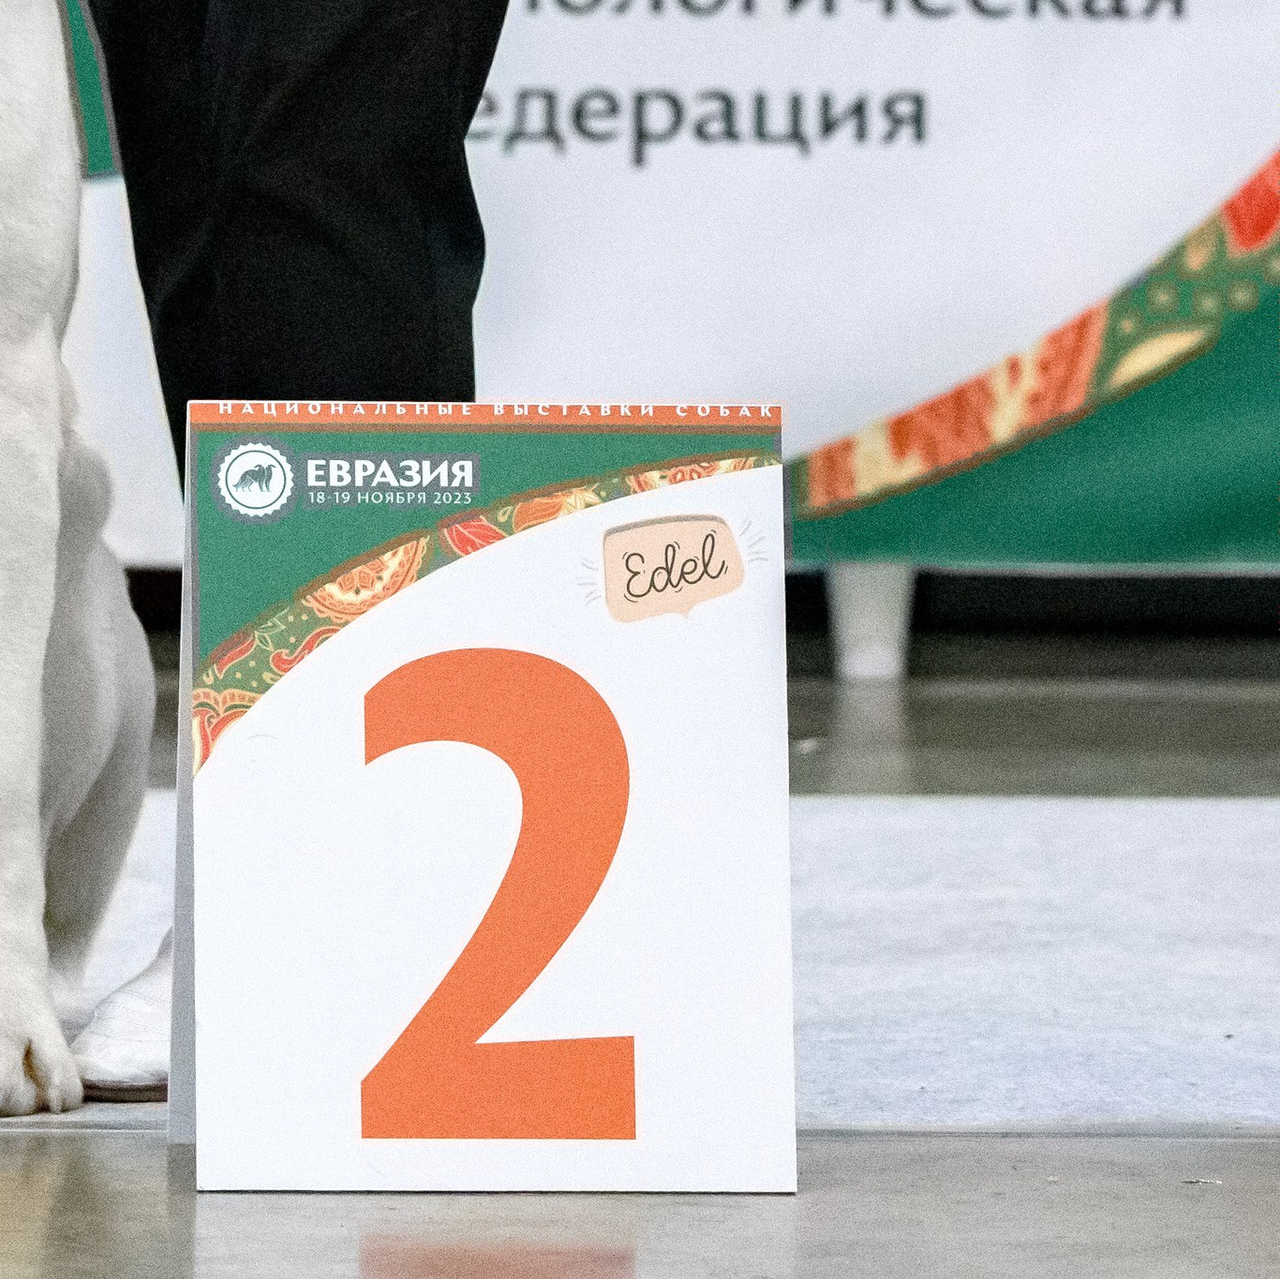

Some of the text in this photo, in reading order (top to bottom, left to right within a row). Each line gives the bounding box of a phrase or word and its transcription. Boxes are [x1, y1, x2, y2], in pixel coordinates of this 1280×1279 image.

[218, 402, 772, 417] НАЦИОНАЛЬНЫЕ ВЫСТАВКИ СОБАК
[307, 459, 473, 487] ЕВРАЗИЯ
[309, 491, 472, 504] 18-19 НОЯБРЯ 2023
[624, 532, 727, 599] Edel
[361, 648, 636, 1140] 2
